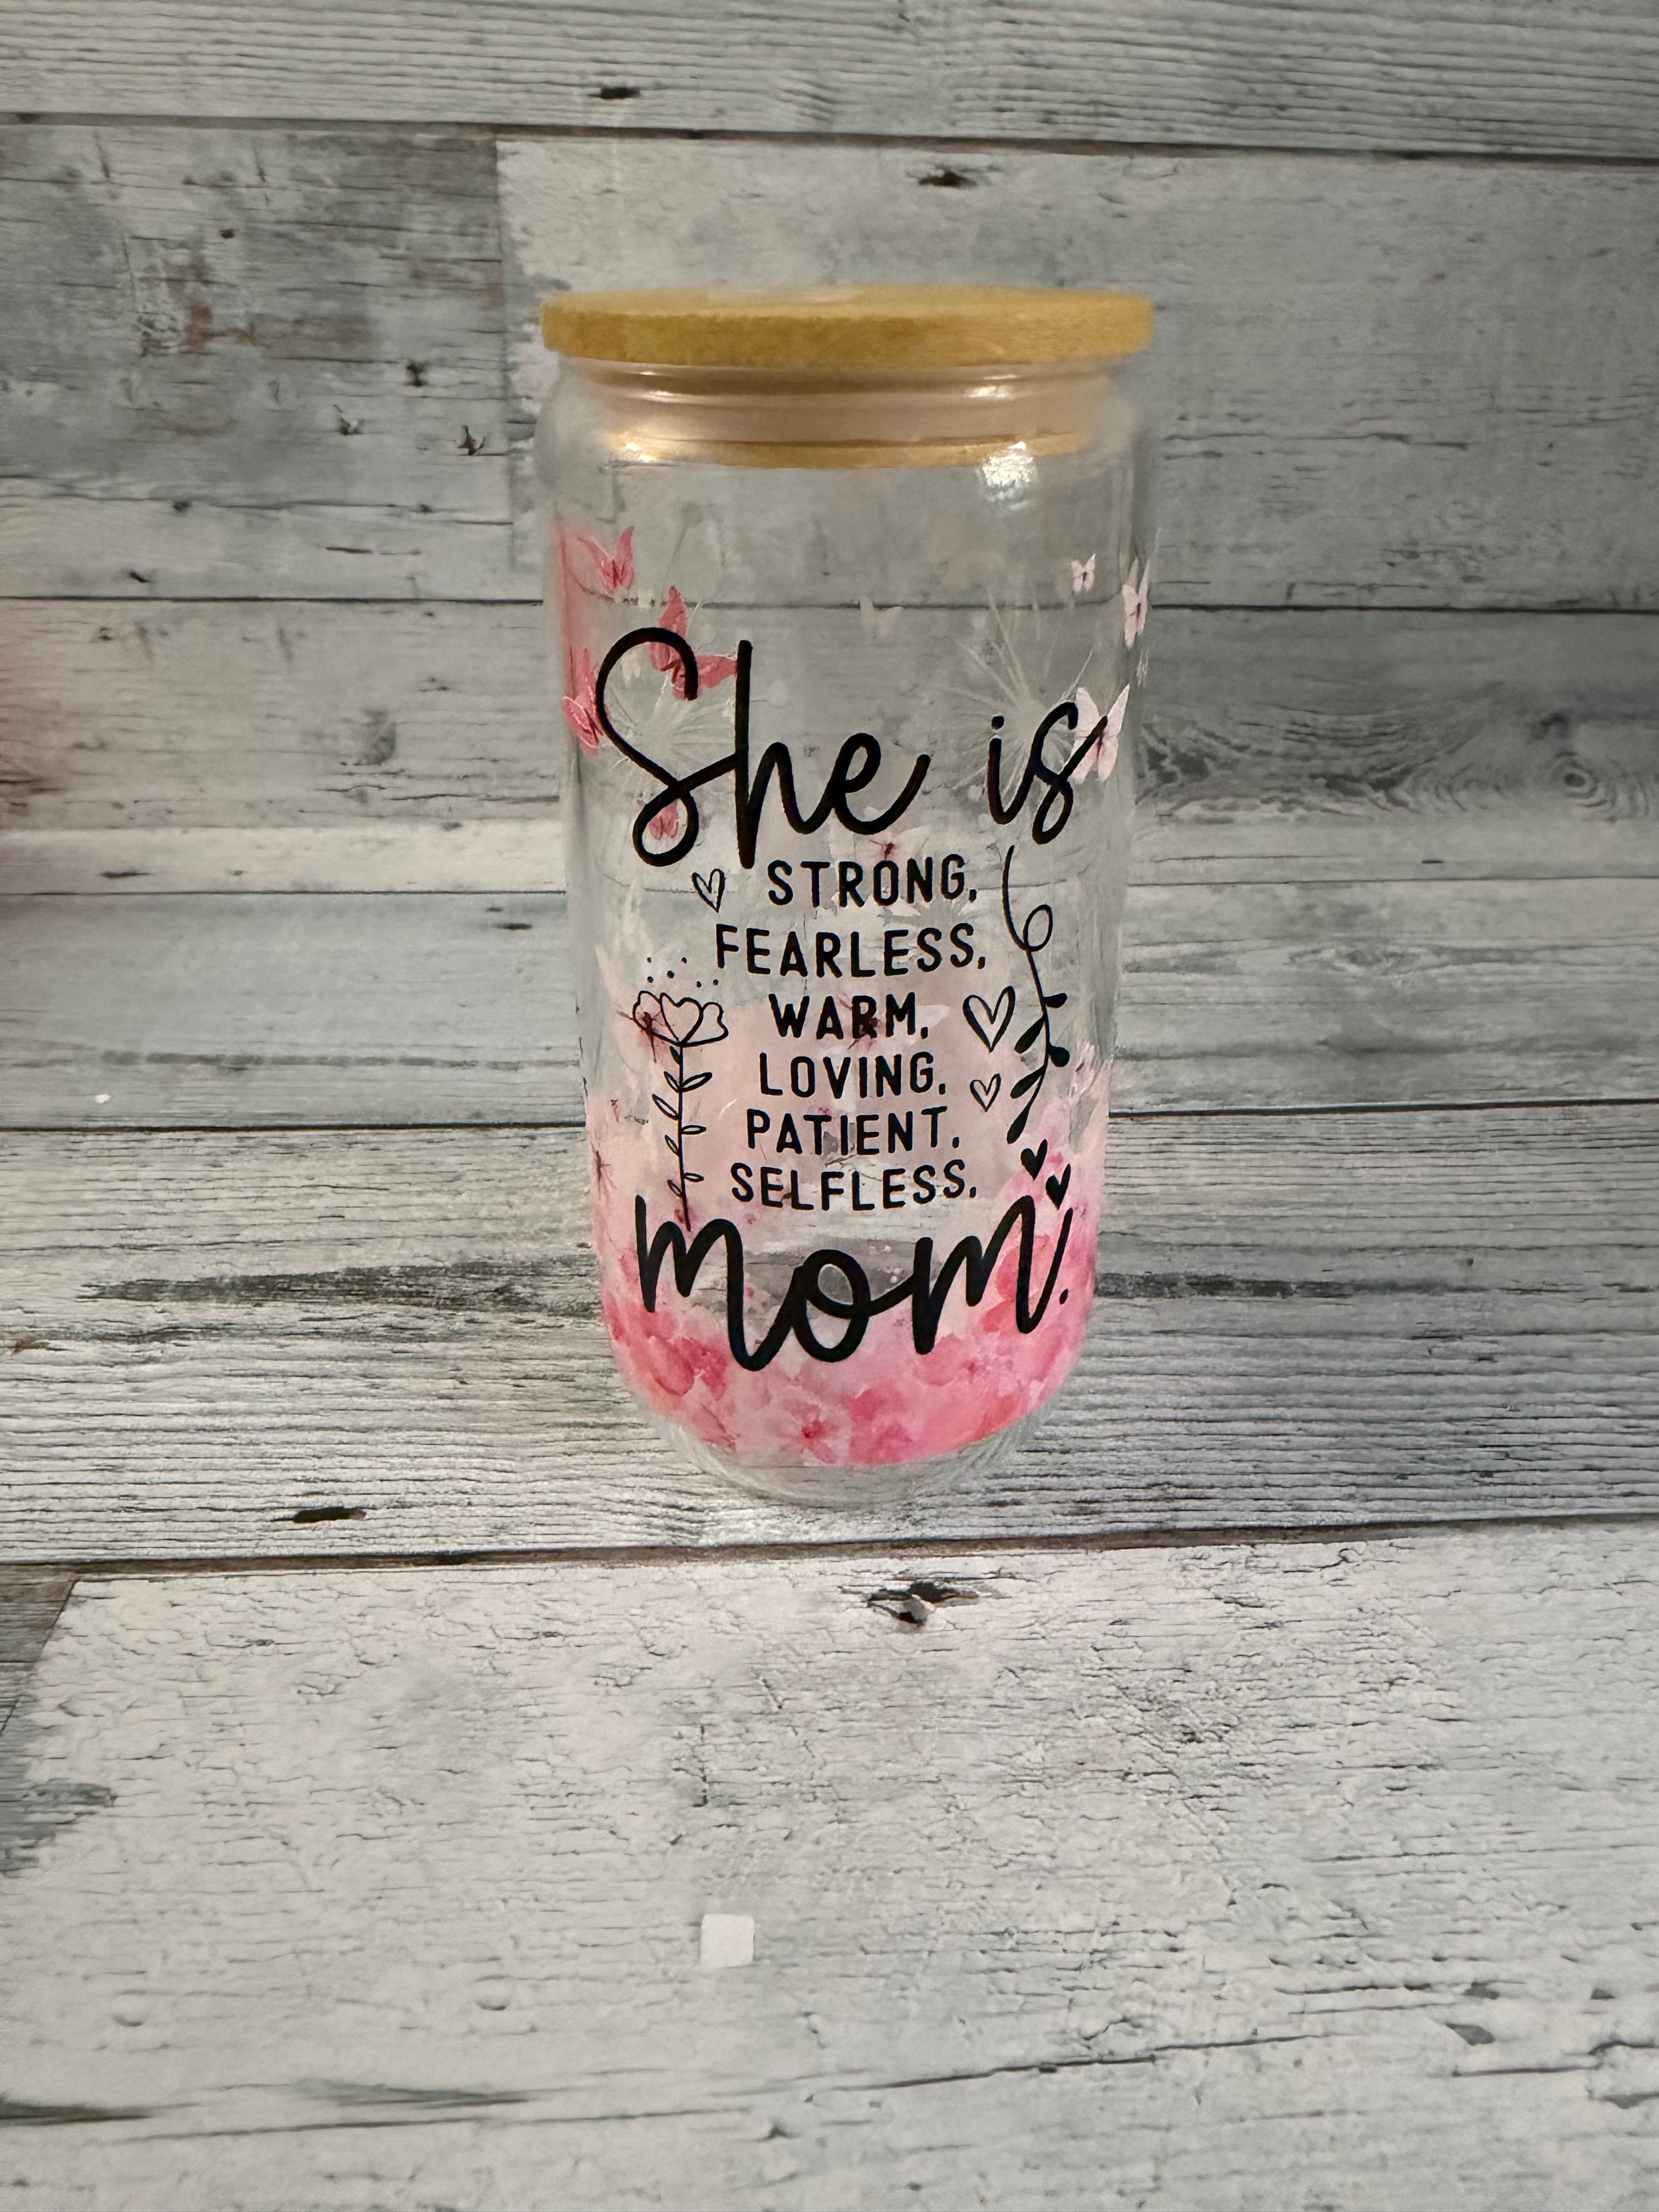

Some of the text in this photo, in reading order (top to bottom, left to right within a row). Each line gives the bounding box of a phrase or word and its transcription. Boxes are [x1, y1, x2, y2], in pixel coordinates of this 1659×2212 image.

[594, 626, 1109, 870] She is
[766, 853, 978, 909] STRONG,
[715, 922, 986, 979] FEARLESS,
